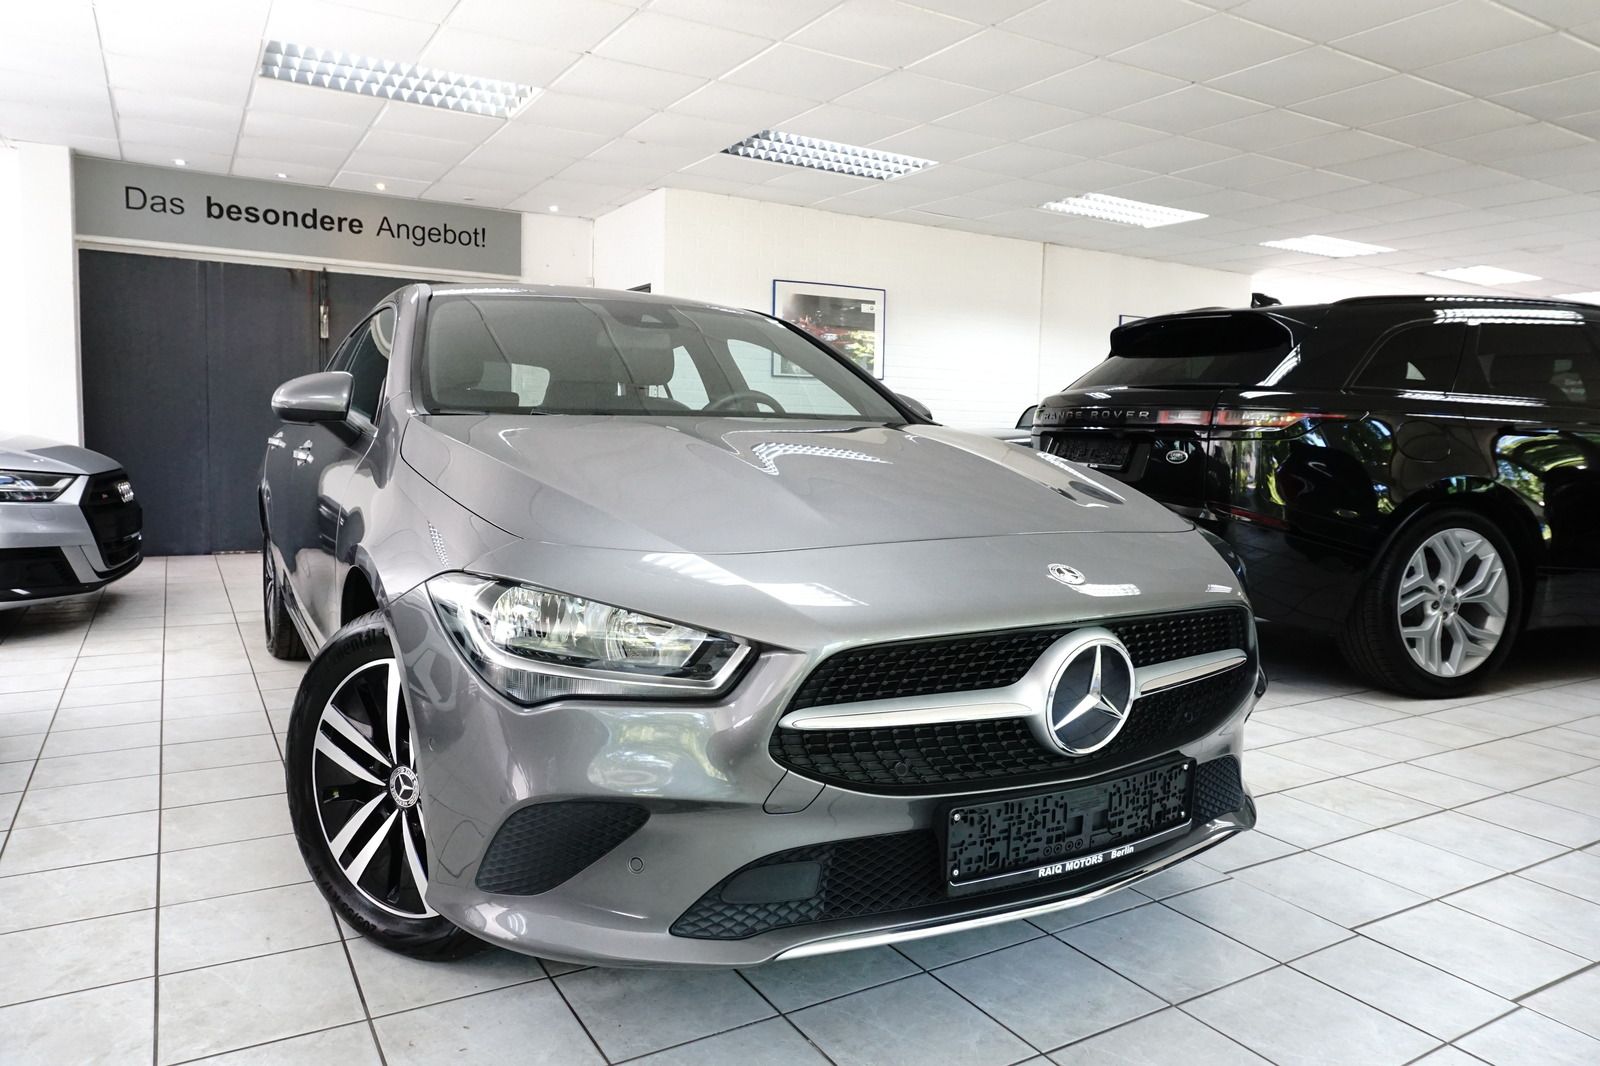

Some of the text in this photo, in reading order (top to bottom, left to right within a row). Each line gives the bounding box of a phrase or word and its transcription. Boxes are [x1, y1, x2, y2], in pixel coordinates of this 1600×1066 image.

[124, 185, 488, 248] Das besondere Angebot!
[1043, 410, 1151, 421] RANGE ROVER
[1038, 845, 1135, 878] RAIQ MOTORS Berlin
